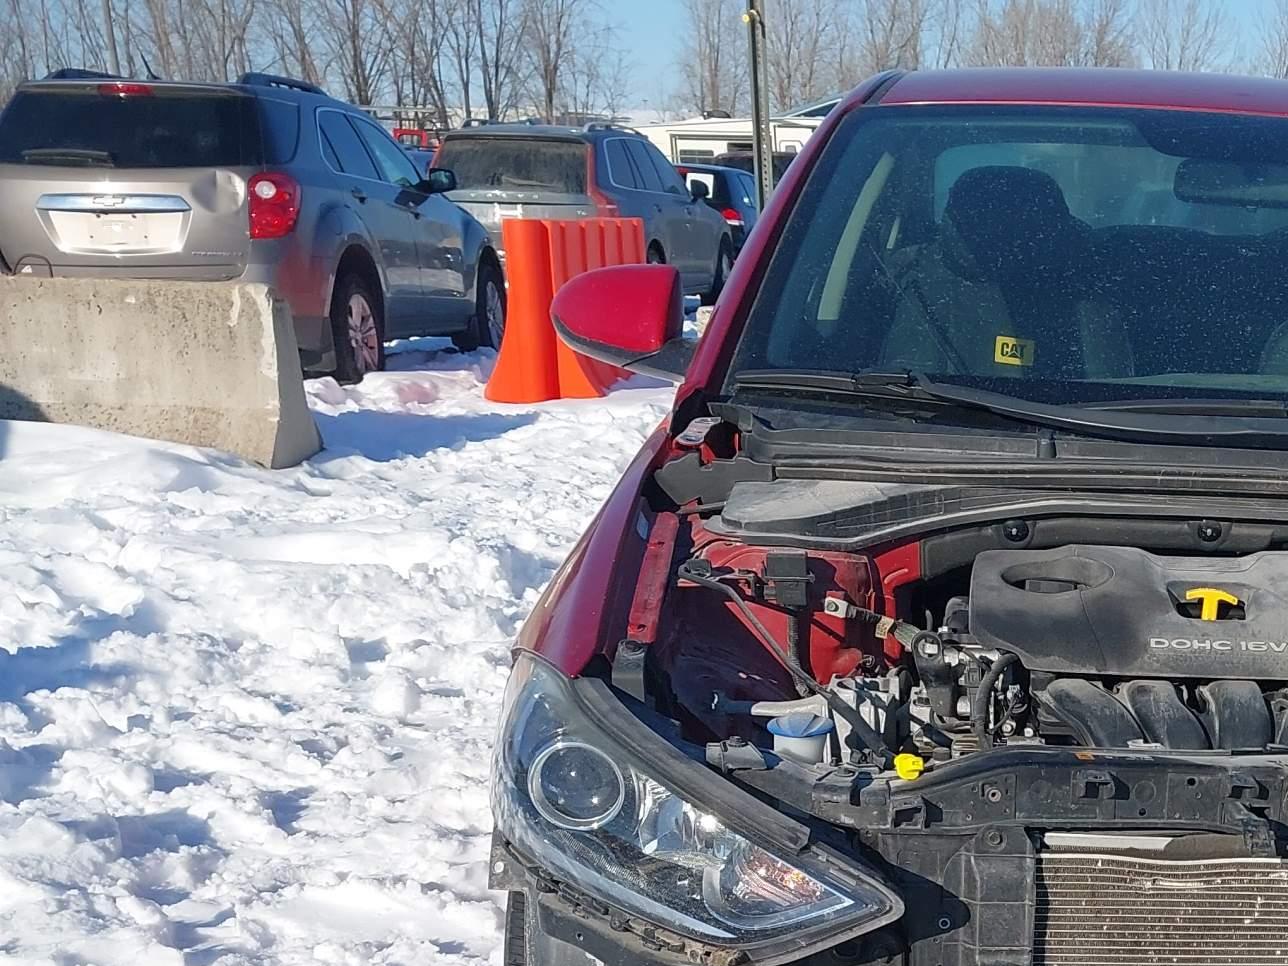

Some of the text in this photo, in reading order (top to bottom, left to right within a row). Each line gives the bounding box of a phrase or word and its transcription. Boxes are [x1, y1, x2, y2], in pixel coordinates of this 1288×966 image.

[1000, 342, 1027, 360] CAT
[1149, 637, 1288, 653] DOHC 16V
